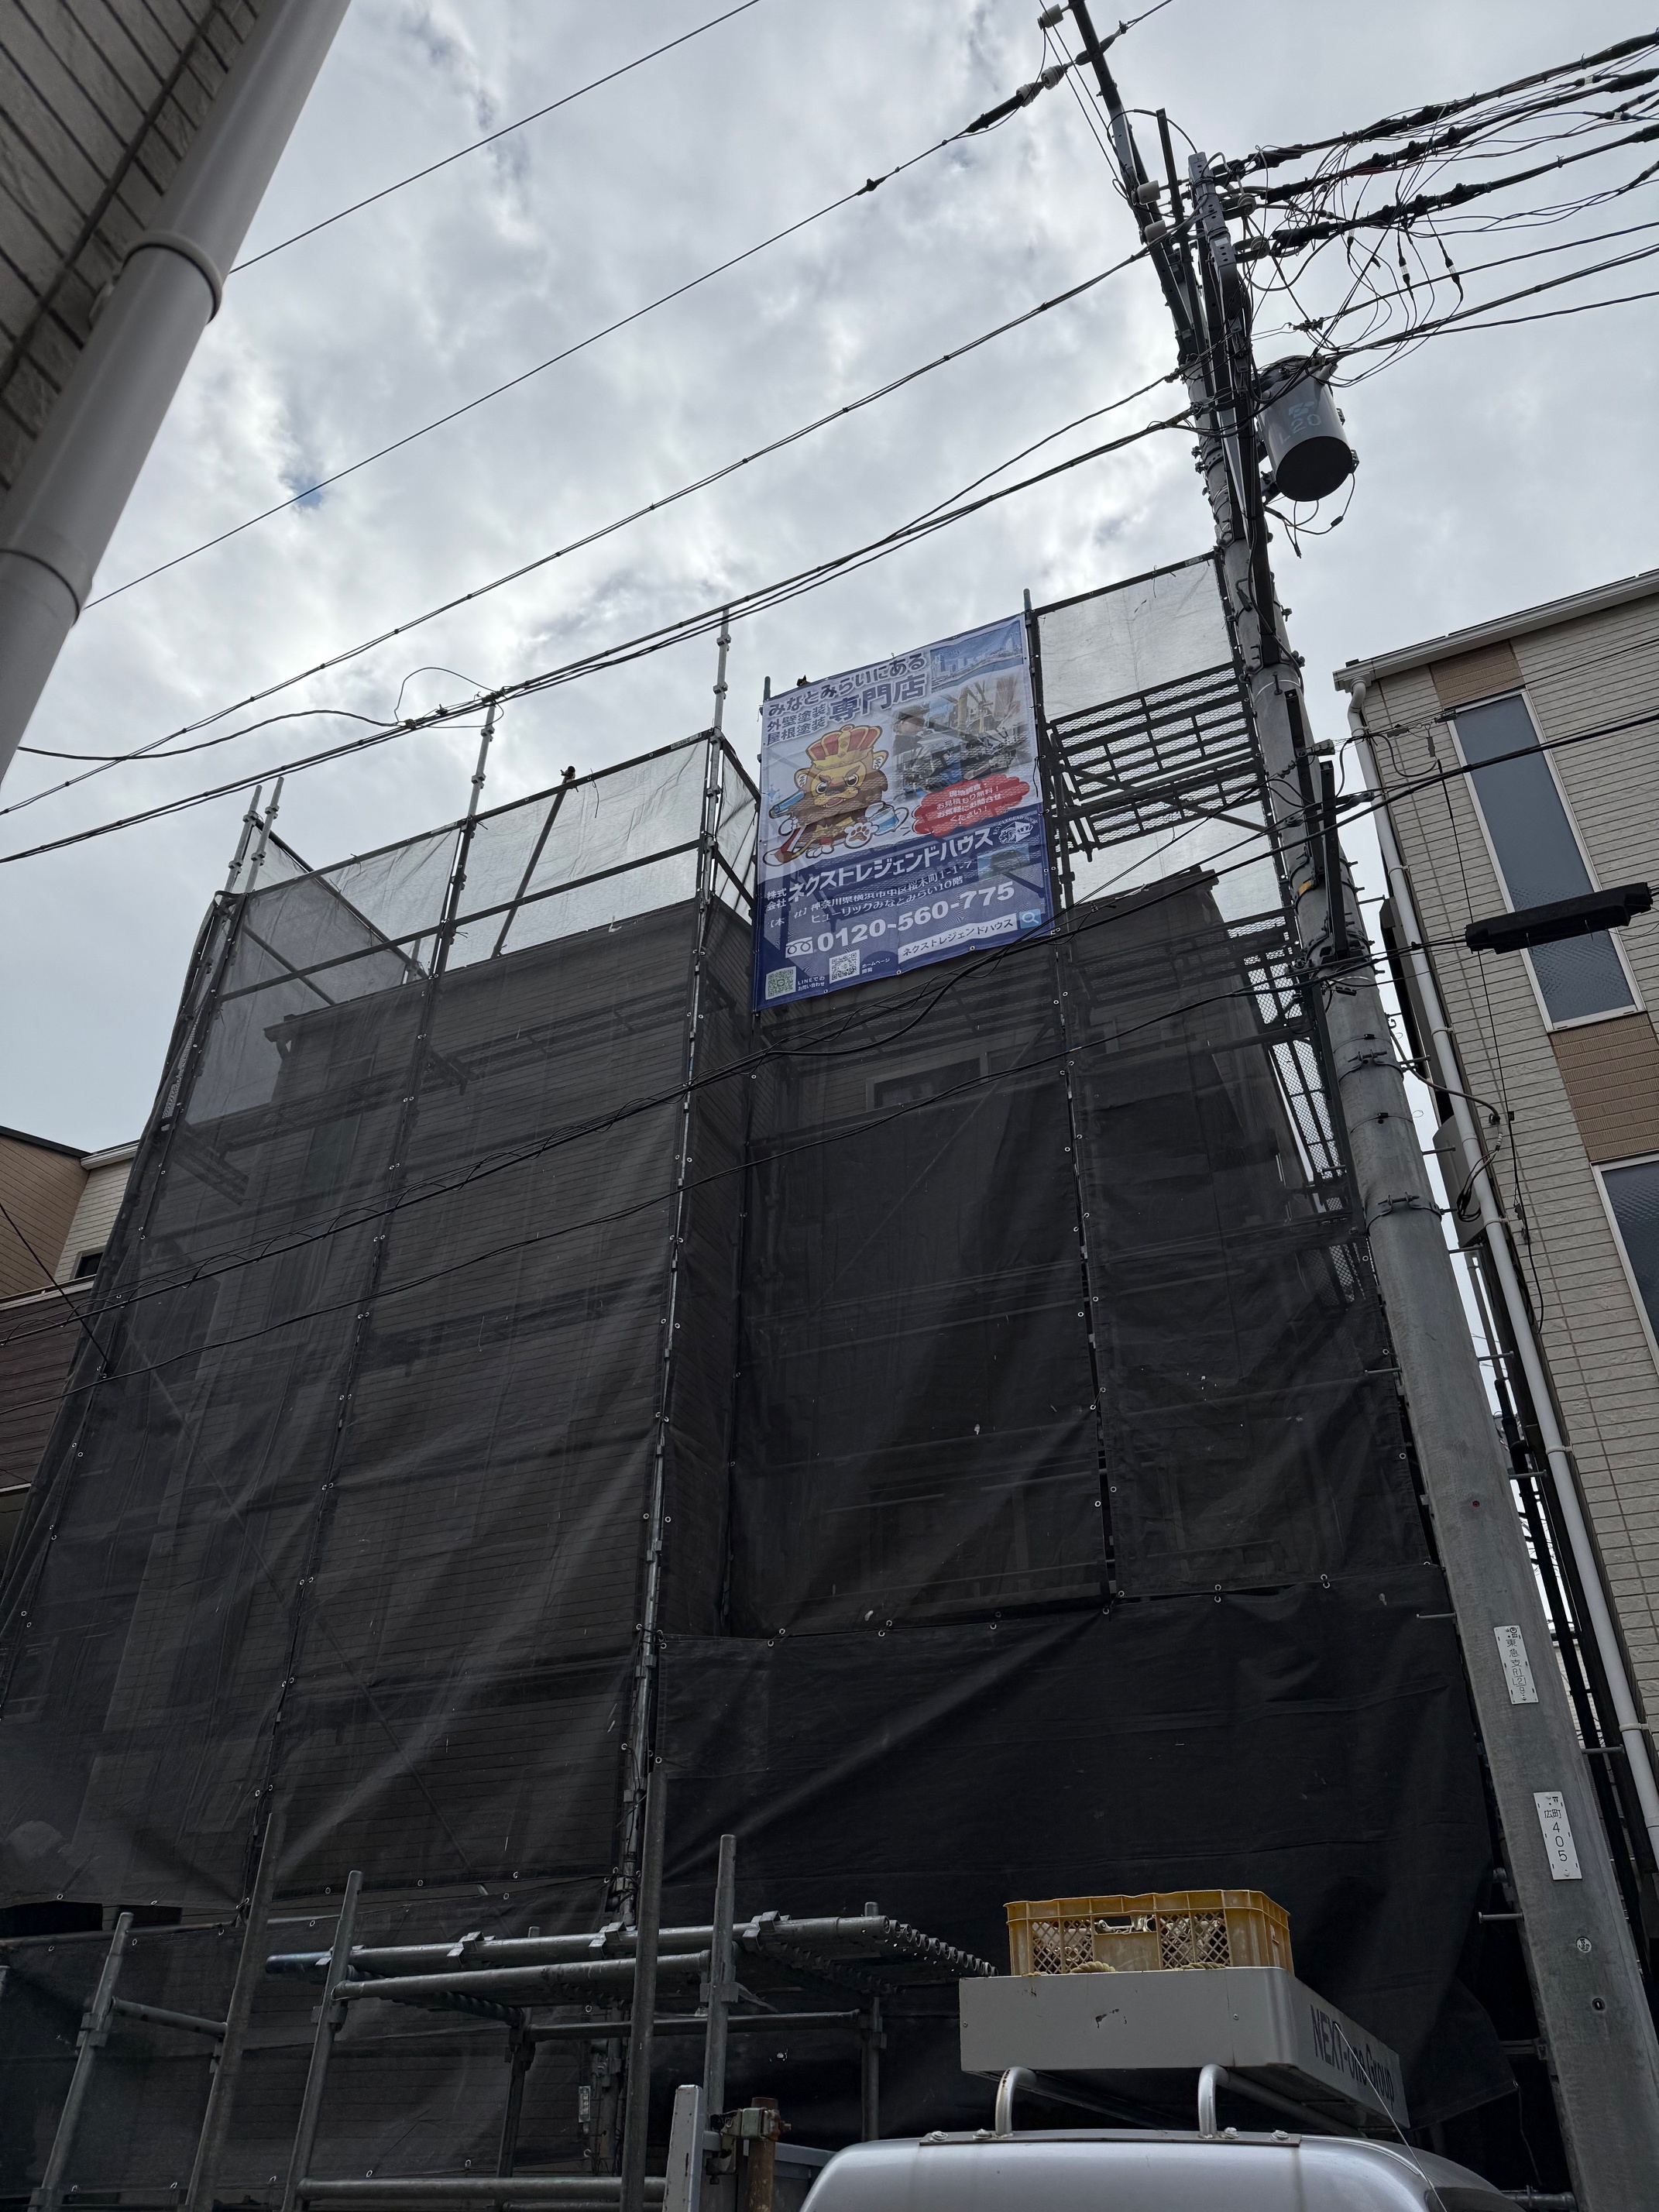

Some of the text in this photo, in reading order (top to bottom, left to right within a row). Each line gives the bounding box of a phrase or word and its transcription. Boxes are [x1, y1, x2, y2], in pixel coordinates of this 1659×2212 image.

[768, 653, 926, 716] みなとみらいにある
[830, 674, 926, 722] 専門店
[767, 703, 826, 732] 外壁塗装
[767, 716, 826, 746] 屋根塗装
[788, 827, 994, 903] ネクストレジェンドハウス
[817, 881, 1015, 953] 0120-560-775
[902, 918, 1014, 957] ネクストレジェンドハウス
[797, 976, 826, 985] LINEでの
[861, 957, 891, 969] ホームページ
[1552, 1822, 1568, 1862] 405
[1366, 2042, 1395, 2112] Group
